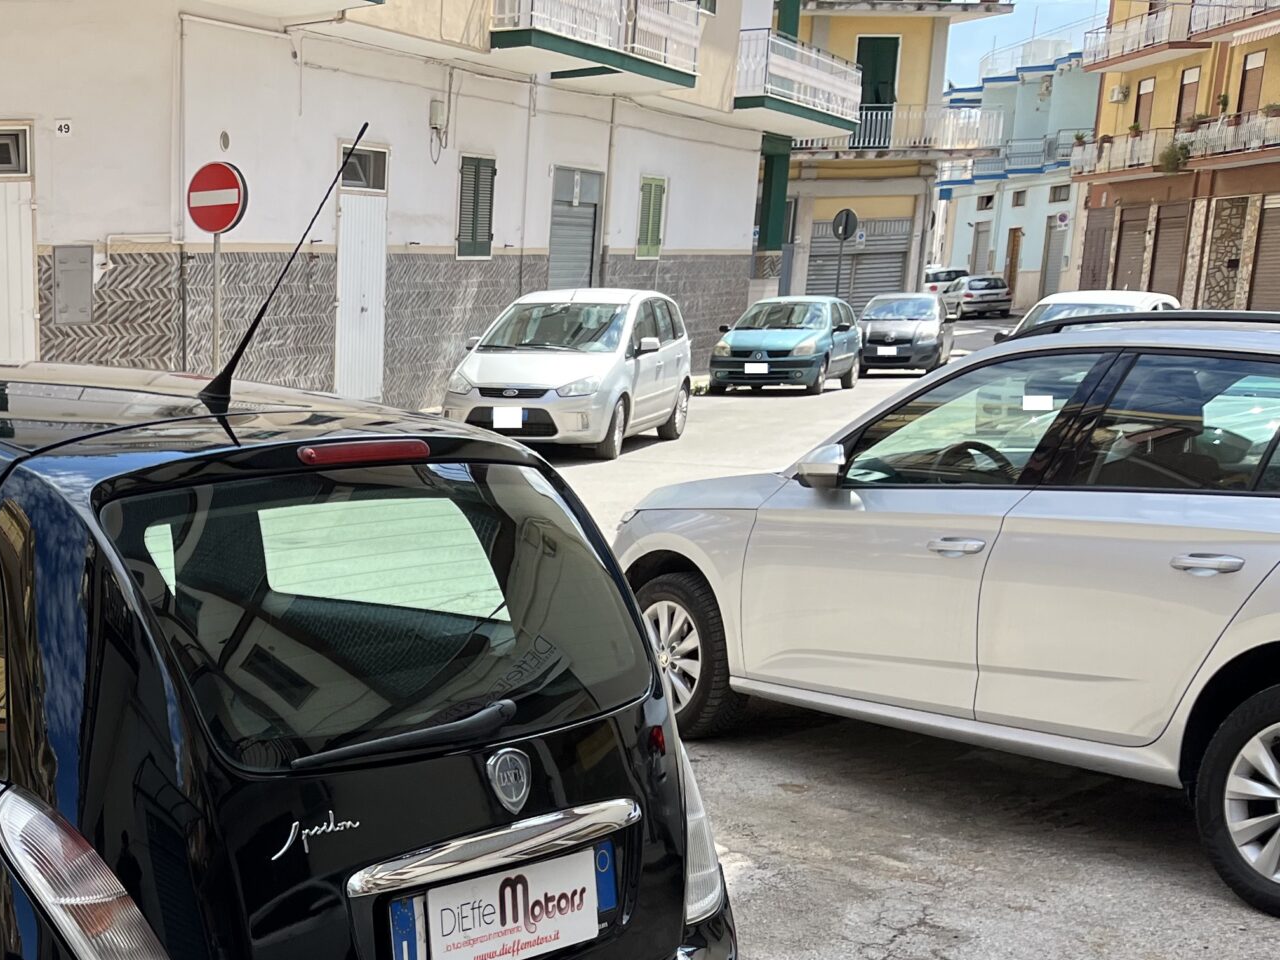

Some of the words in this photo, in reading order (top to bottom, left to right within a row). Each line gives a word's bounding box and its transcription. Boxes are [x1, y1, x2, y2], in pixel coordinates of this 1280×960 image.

[57, 123, 70, 133] 49
[440, 899, 496, 937] DiEffe
[499, 874, 586, 934] Motors
